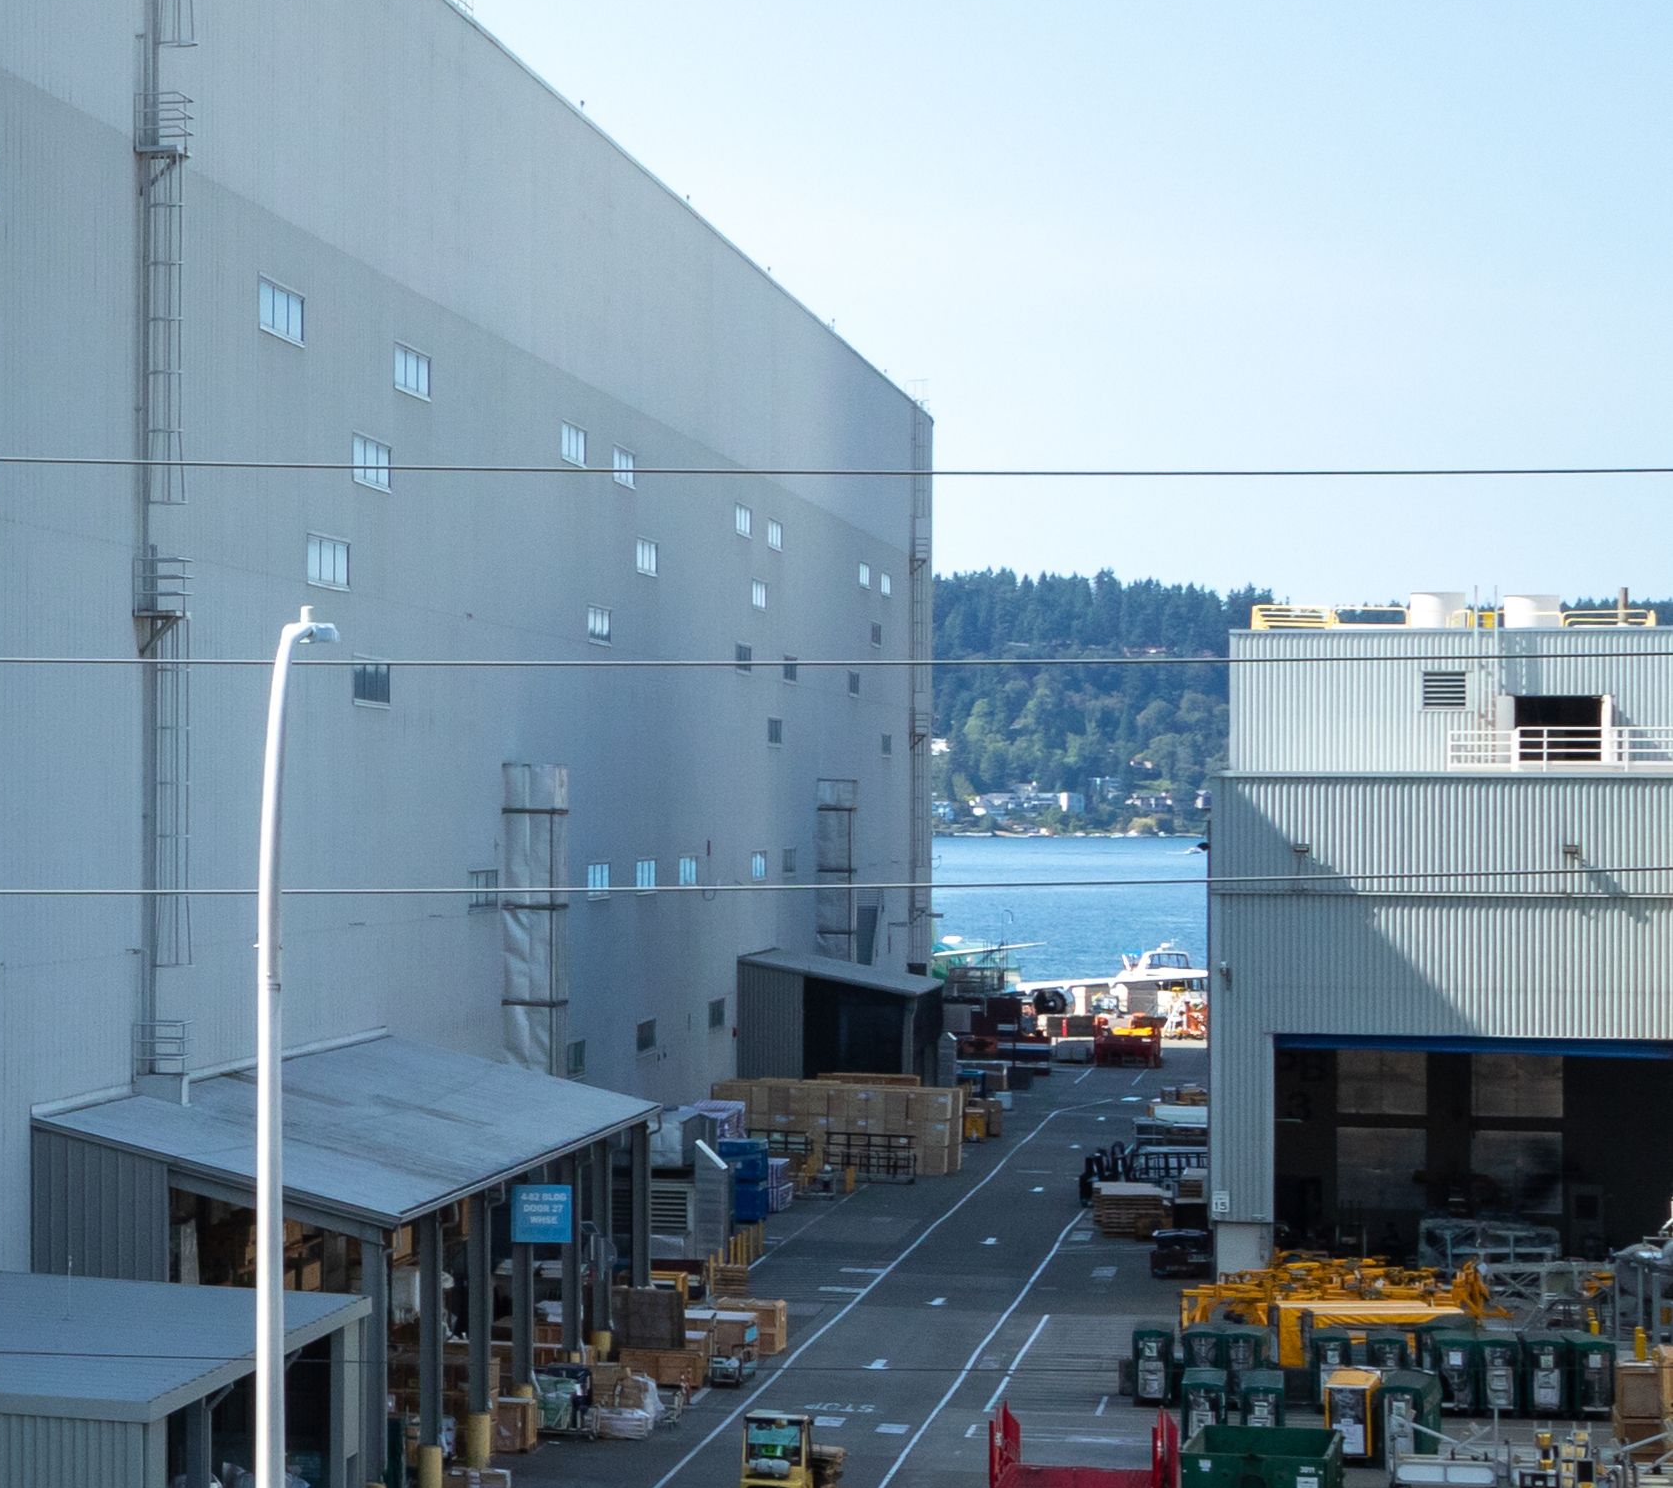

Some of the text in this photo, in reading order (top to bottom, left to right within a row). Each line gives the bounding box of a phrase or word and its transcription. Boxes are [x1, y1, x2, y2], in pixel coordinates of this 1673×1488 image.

[523, 1204, 550, 1213] DOOR
[1215, 1201, 1228, 1211] 15
[804, 1402, 876, 1413] STOP
